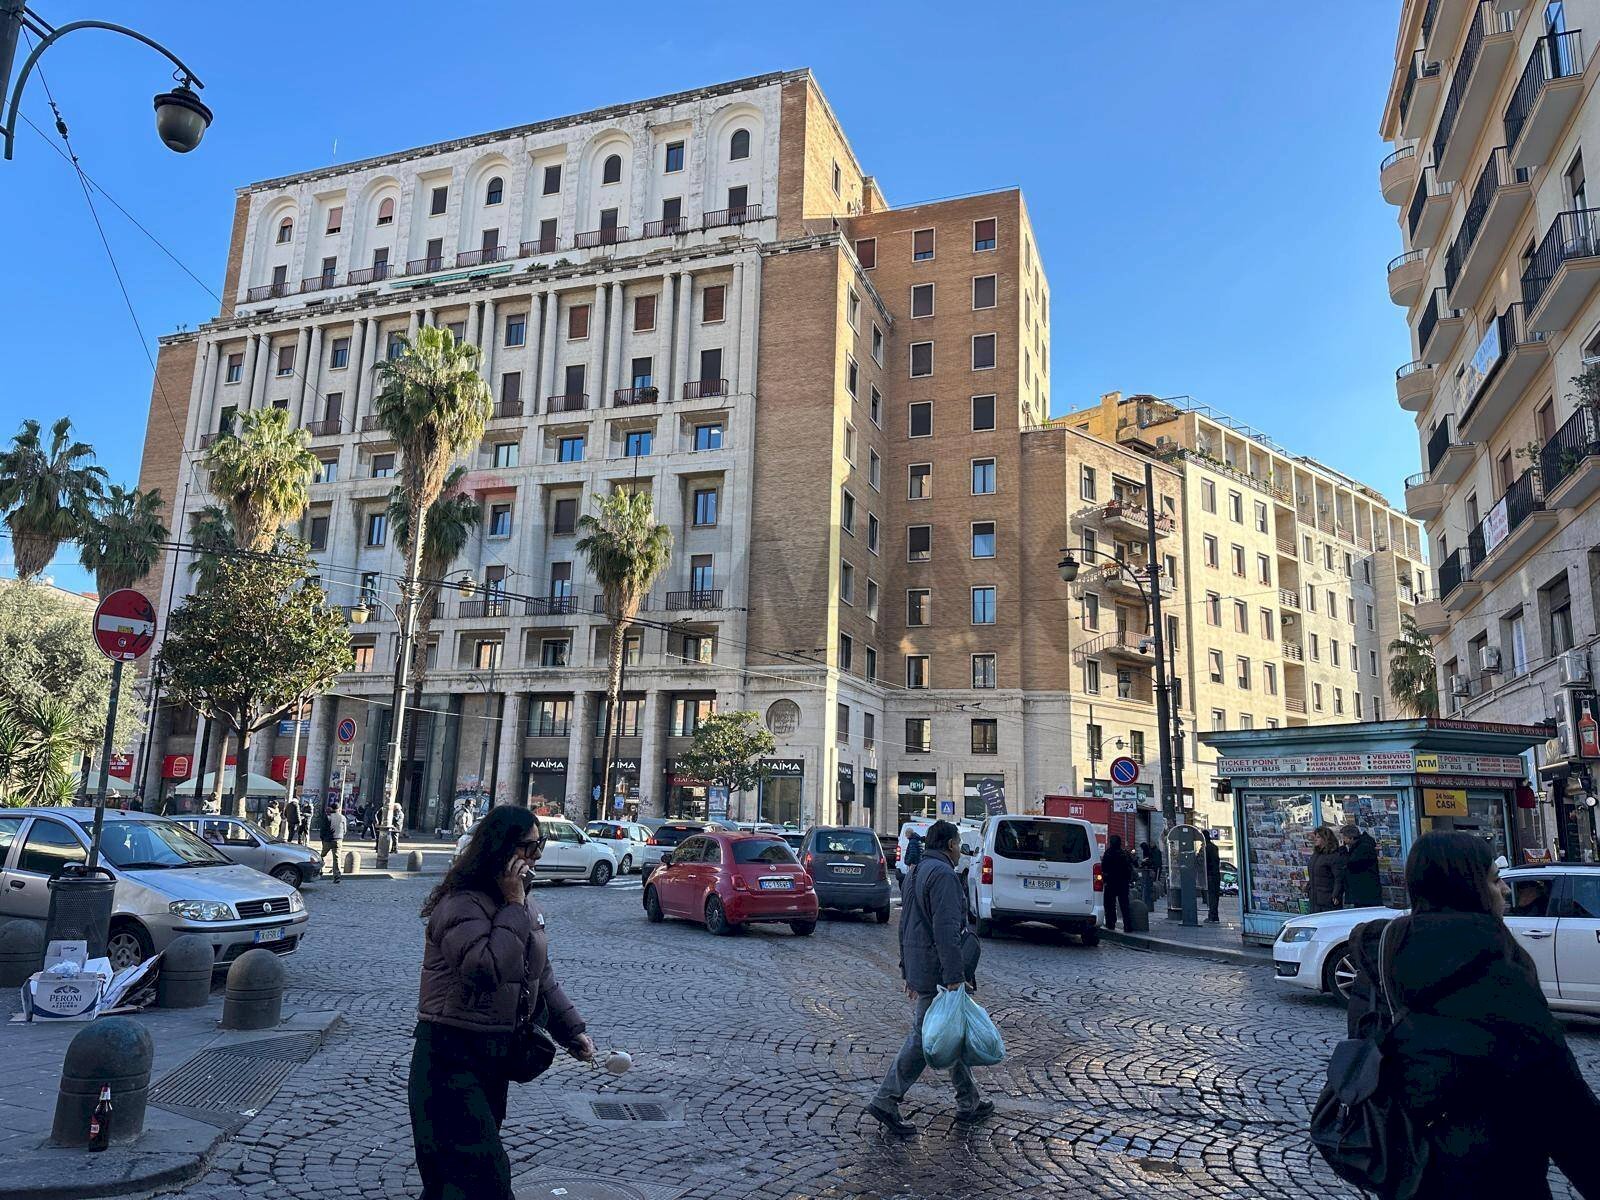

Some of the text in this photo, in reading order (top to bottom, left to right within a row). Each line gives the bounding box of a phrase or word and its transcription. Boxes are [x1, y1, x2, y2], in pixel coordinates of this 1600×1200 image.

[530, 758, 564, 769] NAÏMA
[1221, 759, 1250, 767] TICKET
[1417, 759, 1437, 768] ATM
[1071, 805, 1083, 814] BRT
[50, 994, 82, 1002] PERONI
